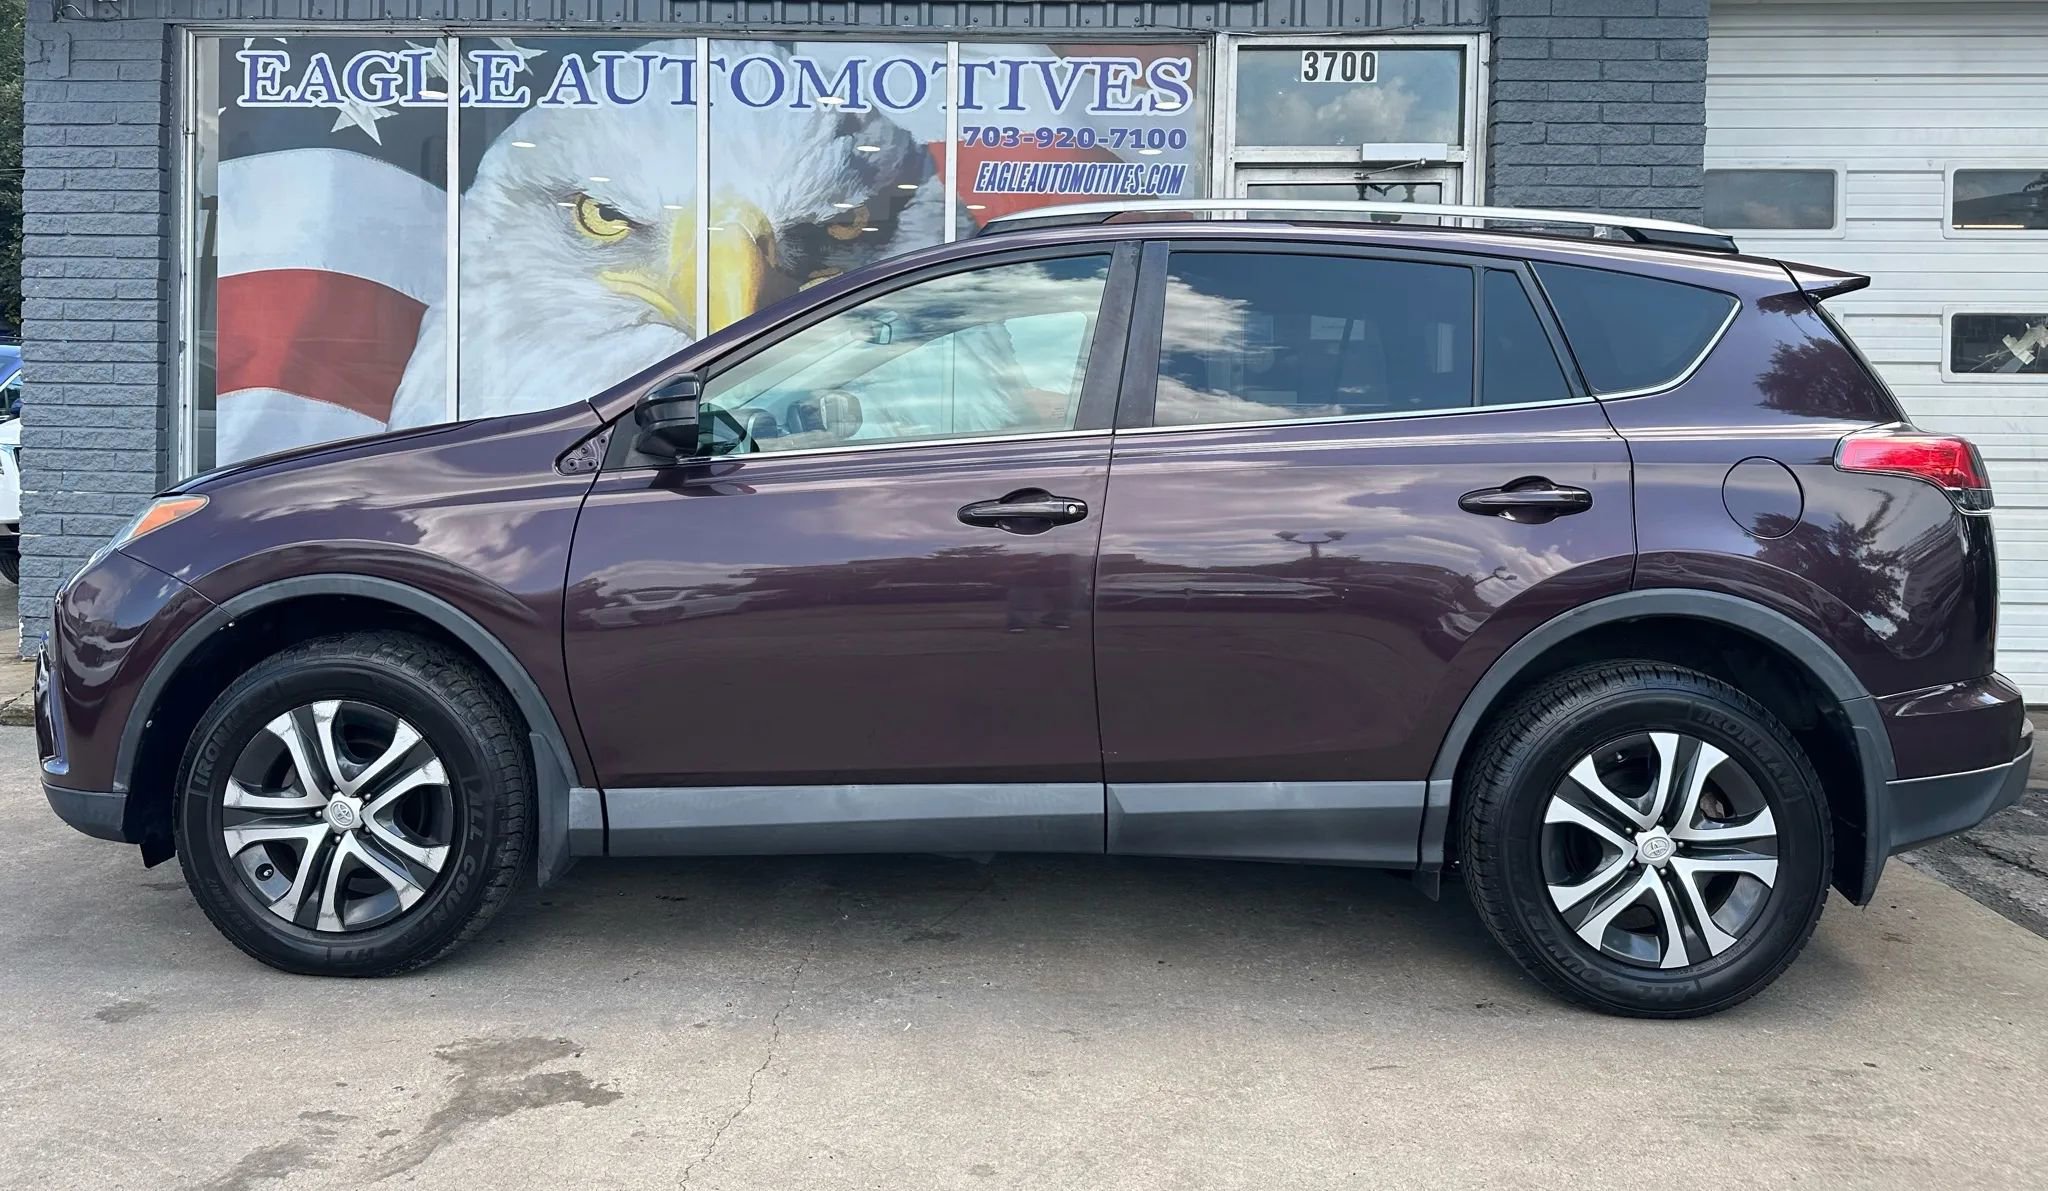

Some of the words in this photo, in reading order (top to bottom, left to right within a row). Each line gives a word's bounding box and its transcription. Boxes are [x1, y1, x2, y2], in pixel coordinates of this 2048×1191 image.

[237, 50, 530, 107] EAGLE
[538, 51, 1195, 116] AUTOMOTIVES
[1303, 51, 1376, 81] 3700
[962, 126, 1188, 150] 703-920-7100
[973, 161, 1188, 196] EAGLEAUTOMOTIVES.COM
[1697, 710, 1801, 799] IRONMAN
